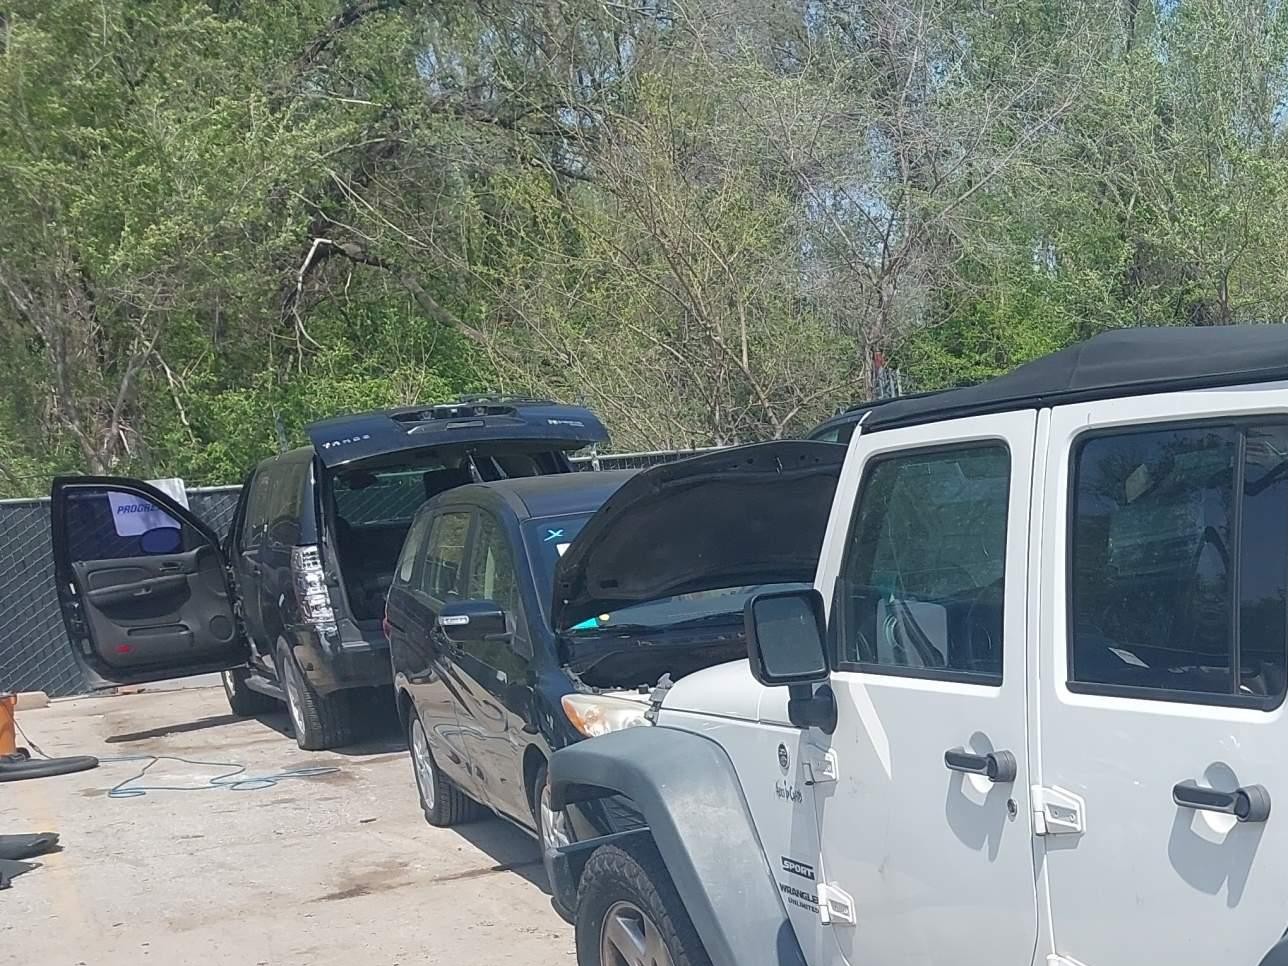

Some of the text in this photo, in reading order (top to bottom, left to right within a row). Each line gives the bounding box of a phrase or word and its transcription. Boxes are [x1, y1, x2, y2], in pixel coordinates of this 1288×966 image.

[117, 503, 160, 515] PROGRE
[783, 860, 813, 878] SPORT
[779, 882, 819, 904] WRANGLE
[788, 897, 820, 914] UNLIMITED
